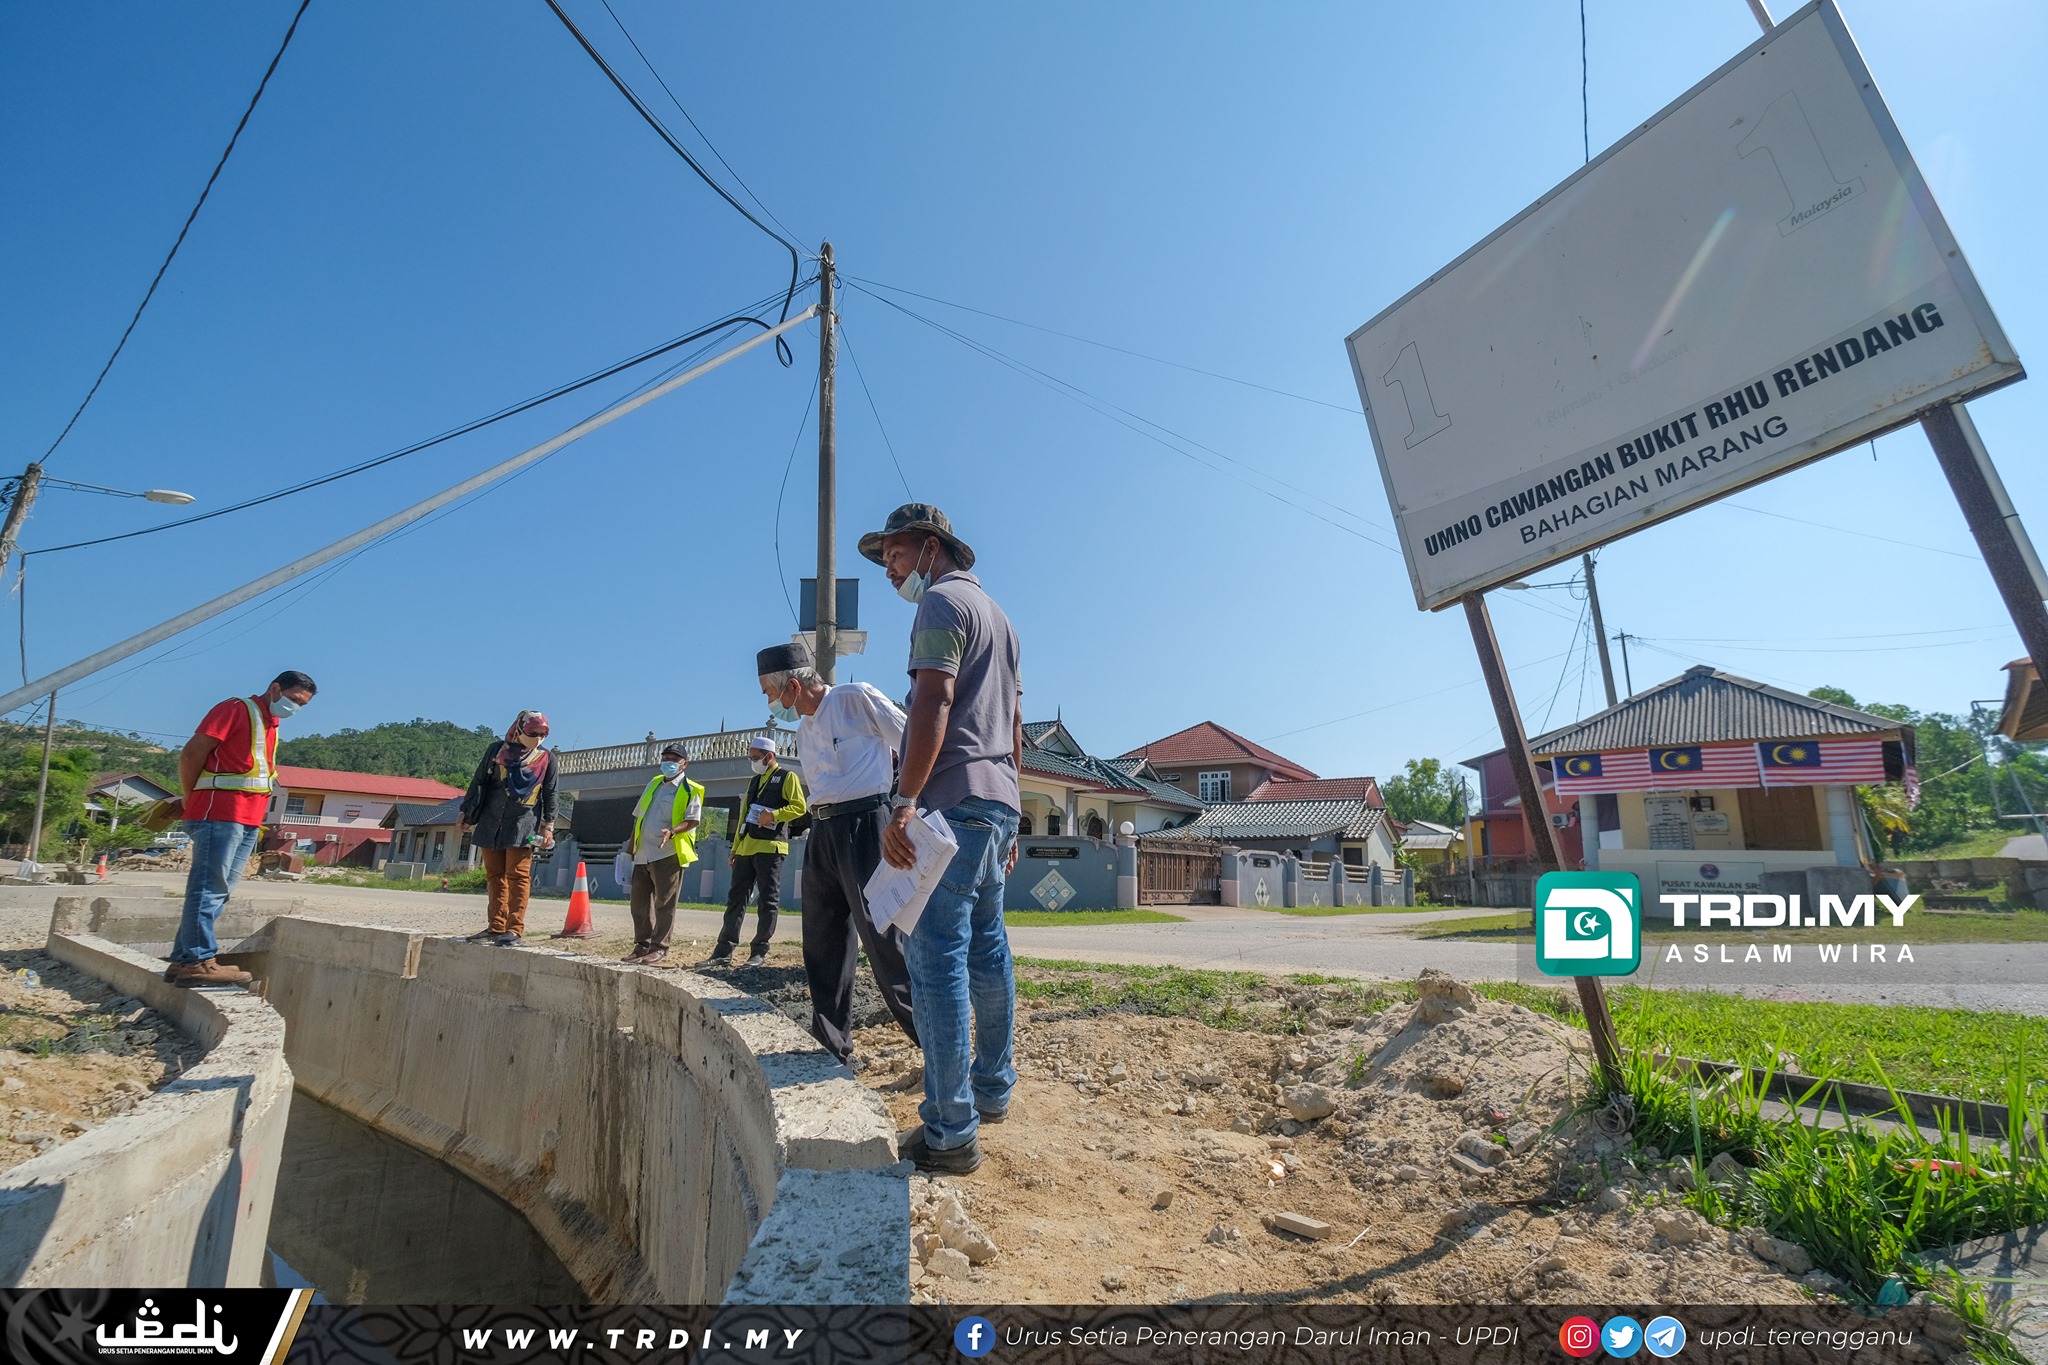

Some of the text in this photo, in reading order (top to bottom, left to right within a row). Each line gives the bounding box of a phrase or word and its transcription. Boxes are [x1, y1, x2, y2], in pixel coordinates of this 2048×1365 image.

[1790, 186, 1852, 226] Malaysia
[1424, 302, 1945, 557] UMNO CAWANGAN BUKIT RHU RENDANG
[1519, 415, 1788, 545] BAHAGIAN MARANG
[1661, 880, 1692, 888] PUSAT
[1694, 881, 1742, 890] KAWALAN
